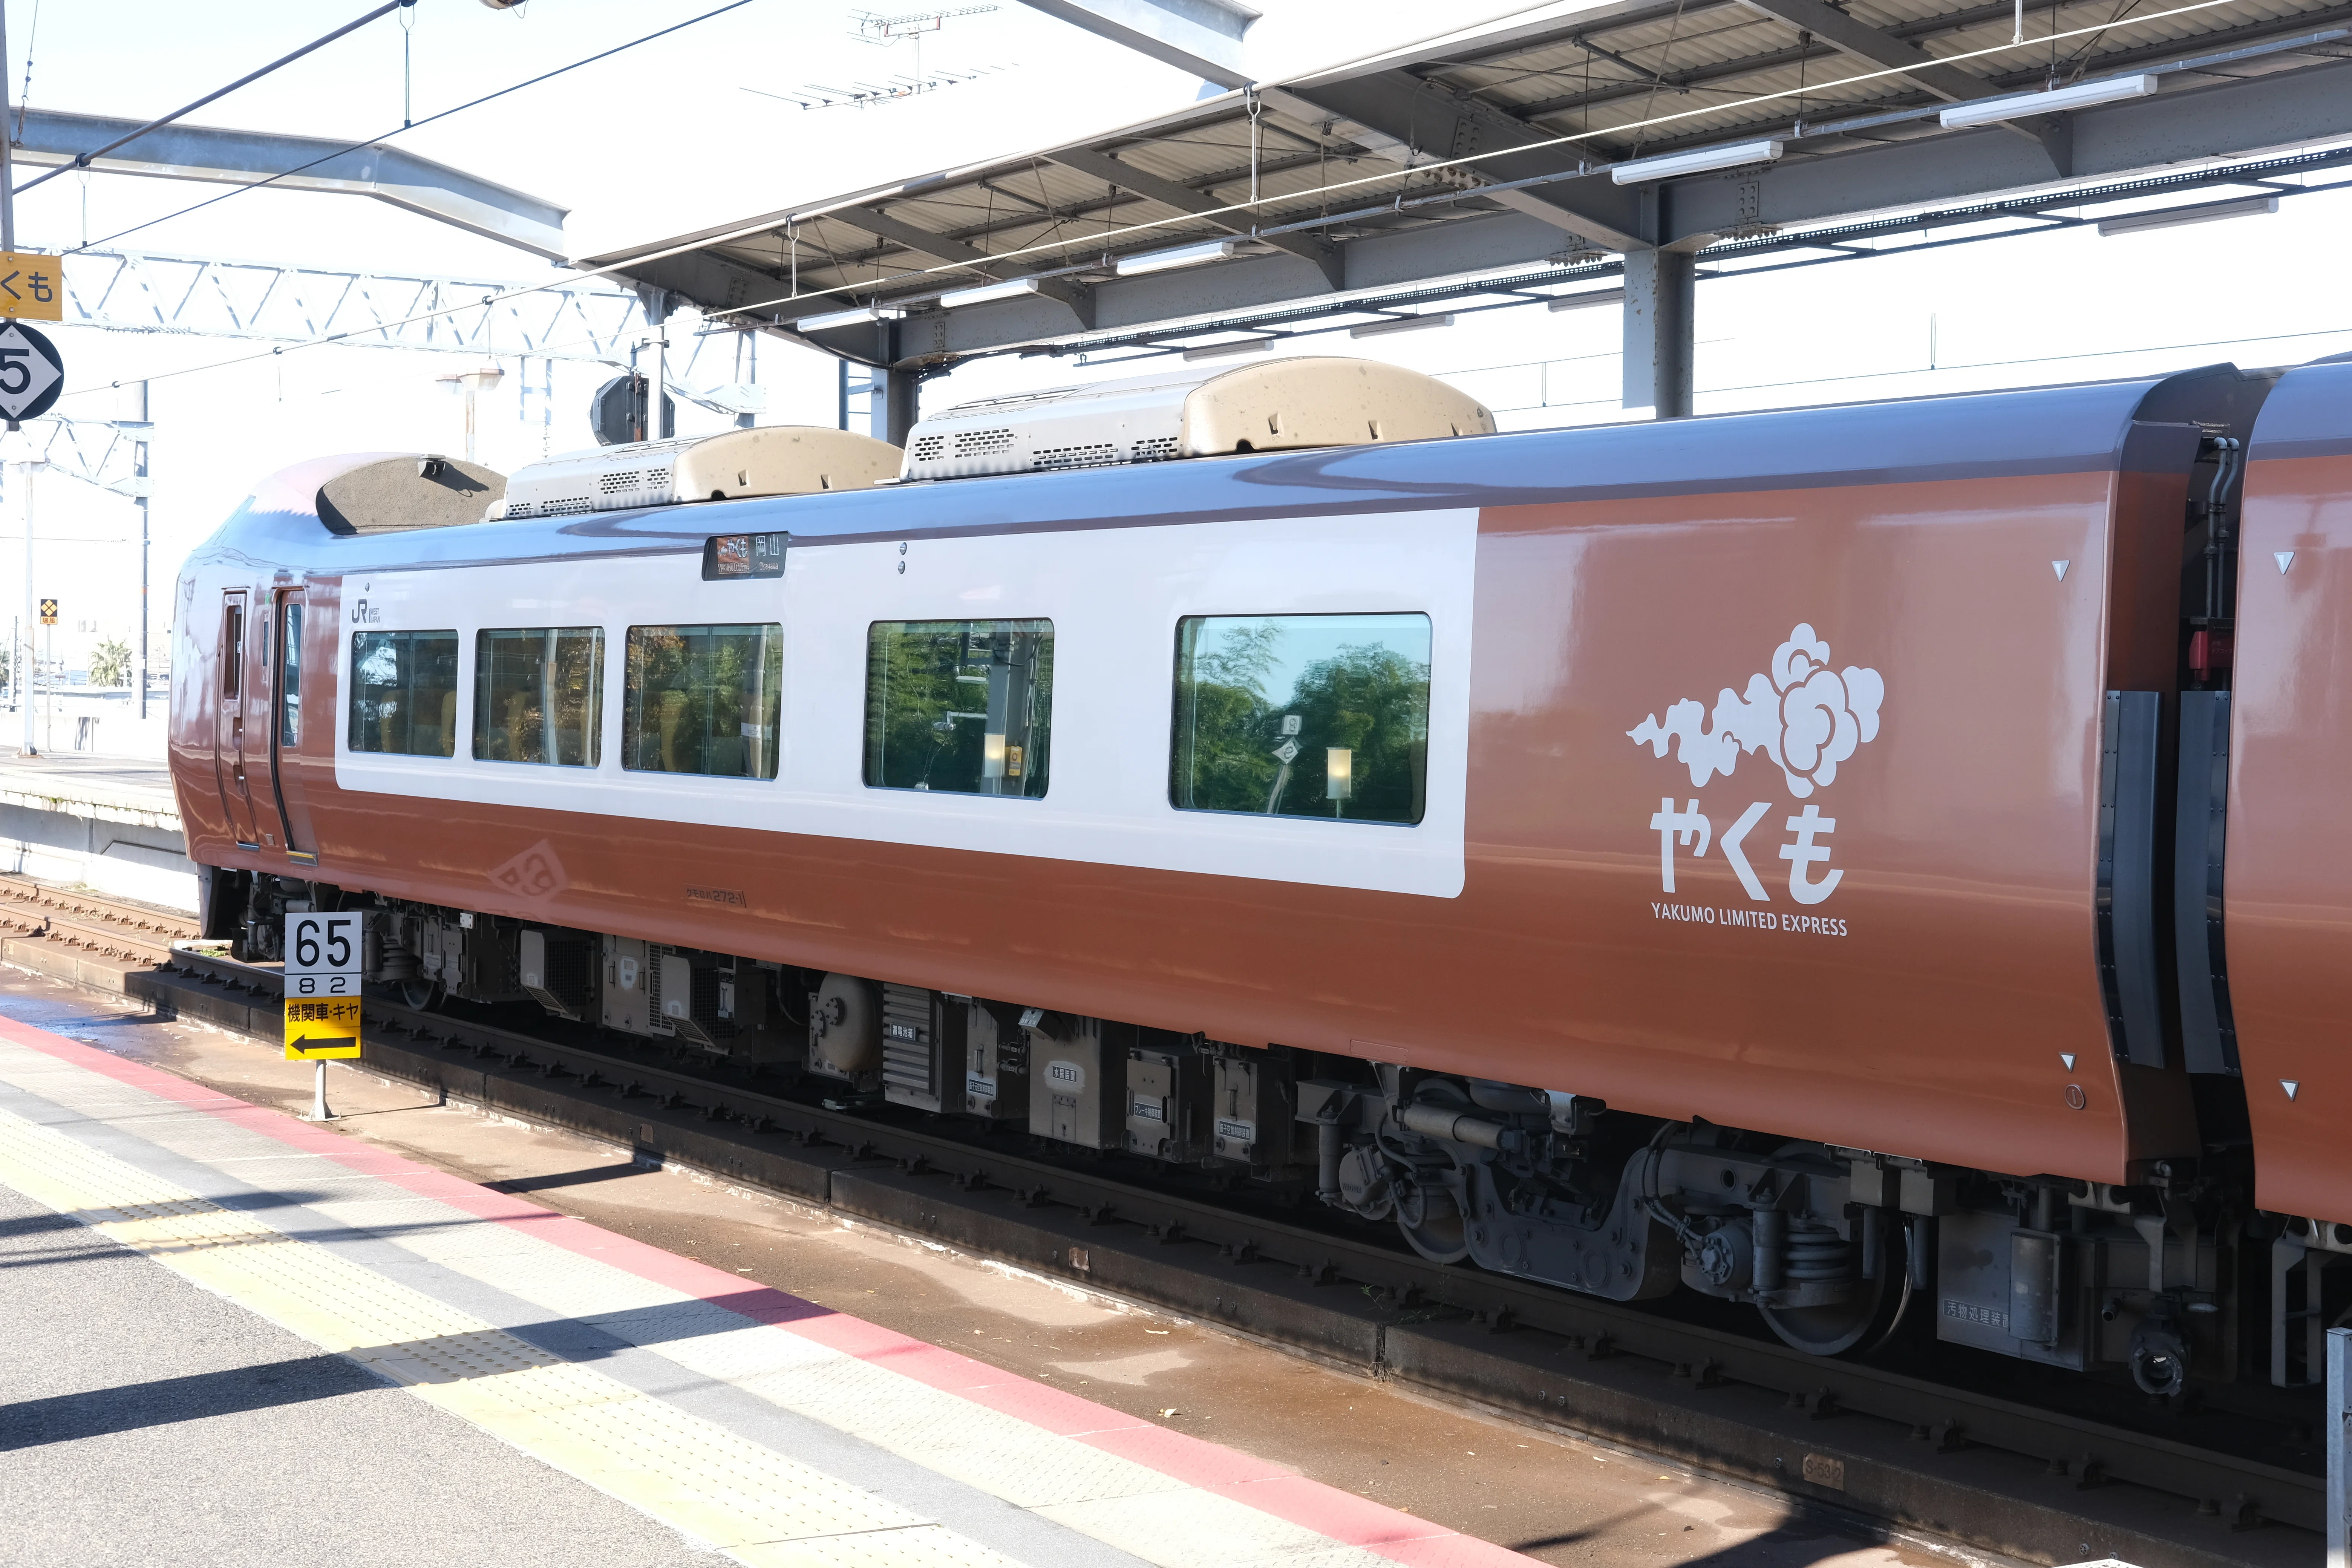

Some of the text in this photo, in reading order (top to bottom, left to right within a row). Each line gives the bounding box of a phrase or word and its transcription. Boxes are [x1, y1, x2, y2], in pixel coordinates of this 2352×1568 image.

[0, 348, 31, 394] 5
[727, 534, 779, 558] やくも 岡山
[759, 561, 778, 571] Okayama
[352, 599, 367, 624] JR
[1650, 797, 1844, 905] やくも
[1651, 902, 1848, 937] YAKUMO LIMITED EXPRESS
[296, 920, 351, 967] 65
[893, 1025, 913, 1038] 蓄電池箱
[1054, 1067, 1075, 1081] 水揚装置
[1135, 1104, 1161, 1119] ブレーキ制御装置
[1220, 1123, 1250, 1138] 振子空気制御装置
[1805, 1459, 1841, 1483] S-53-2
